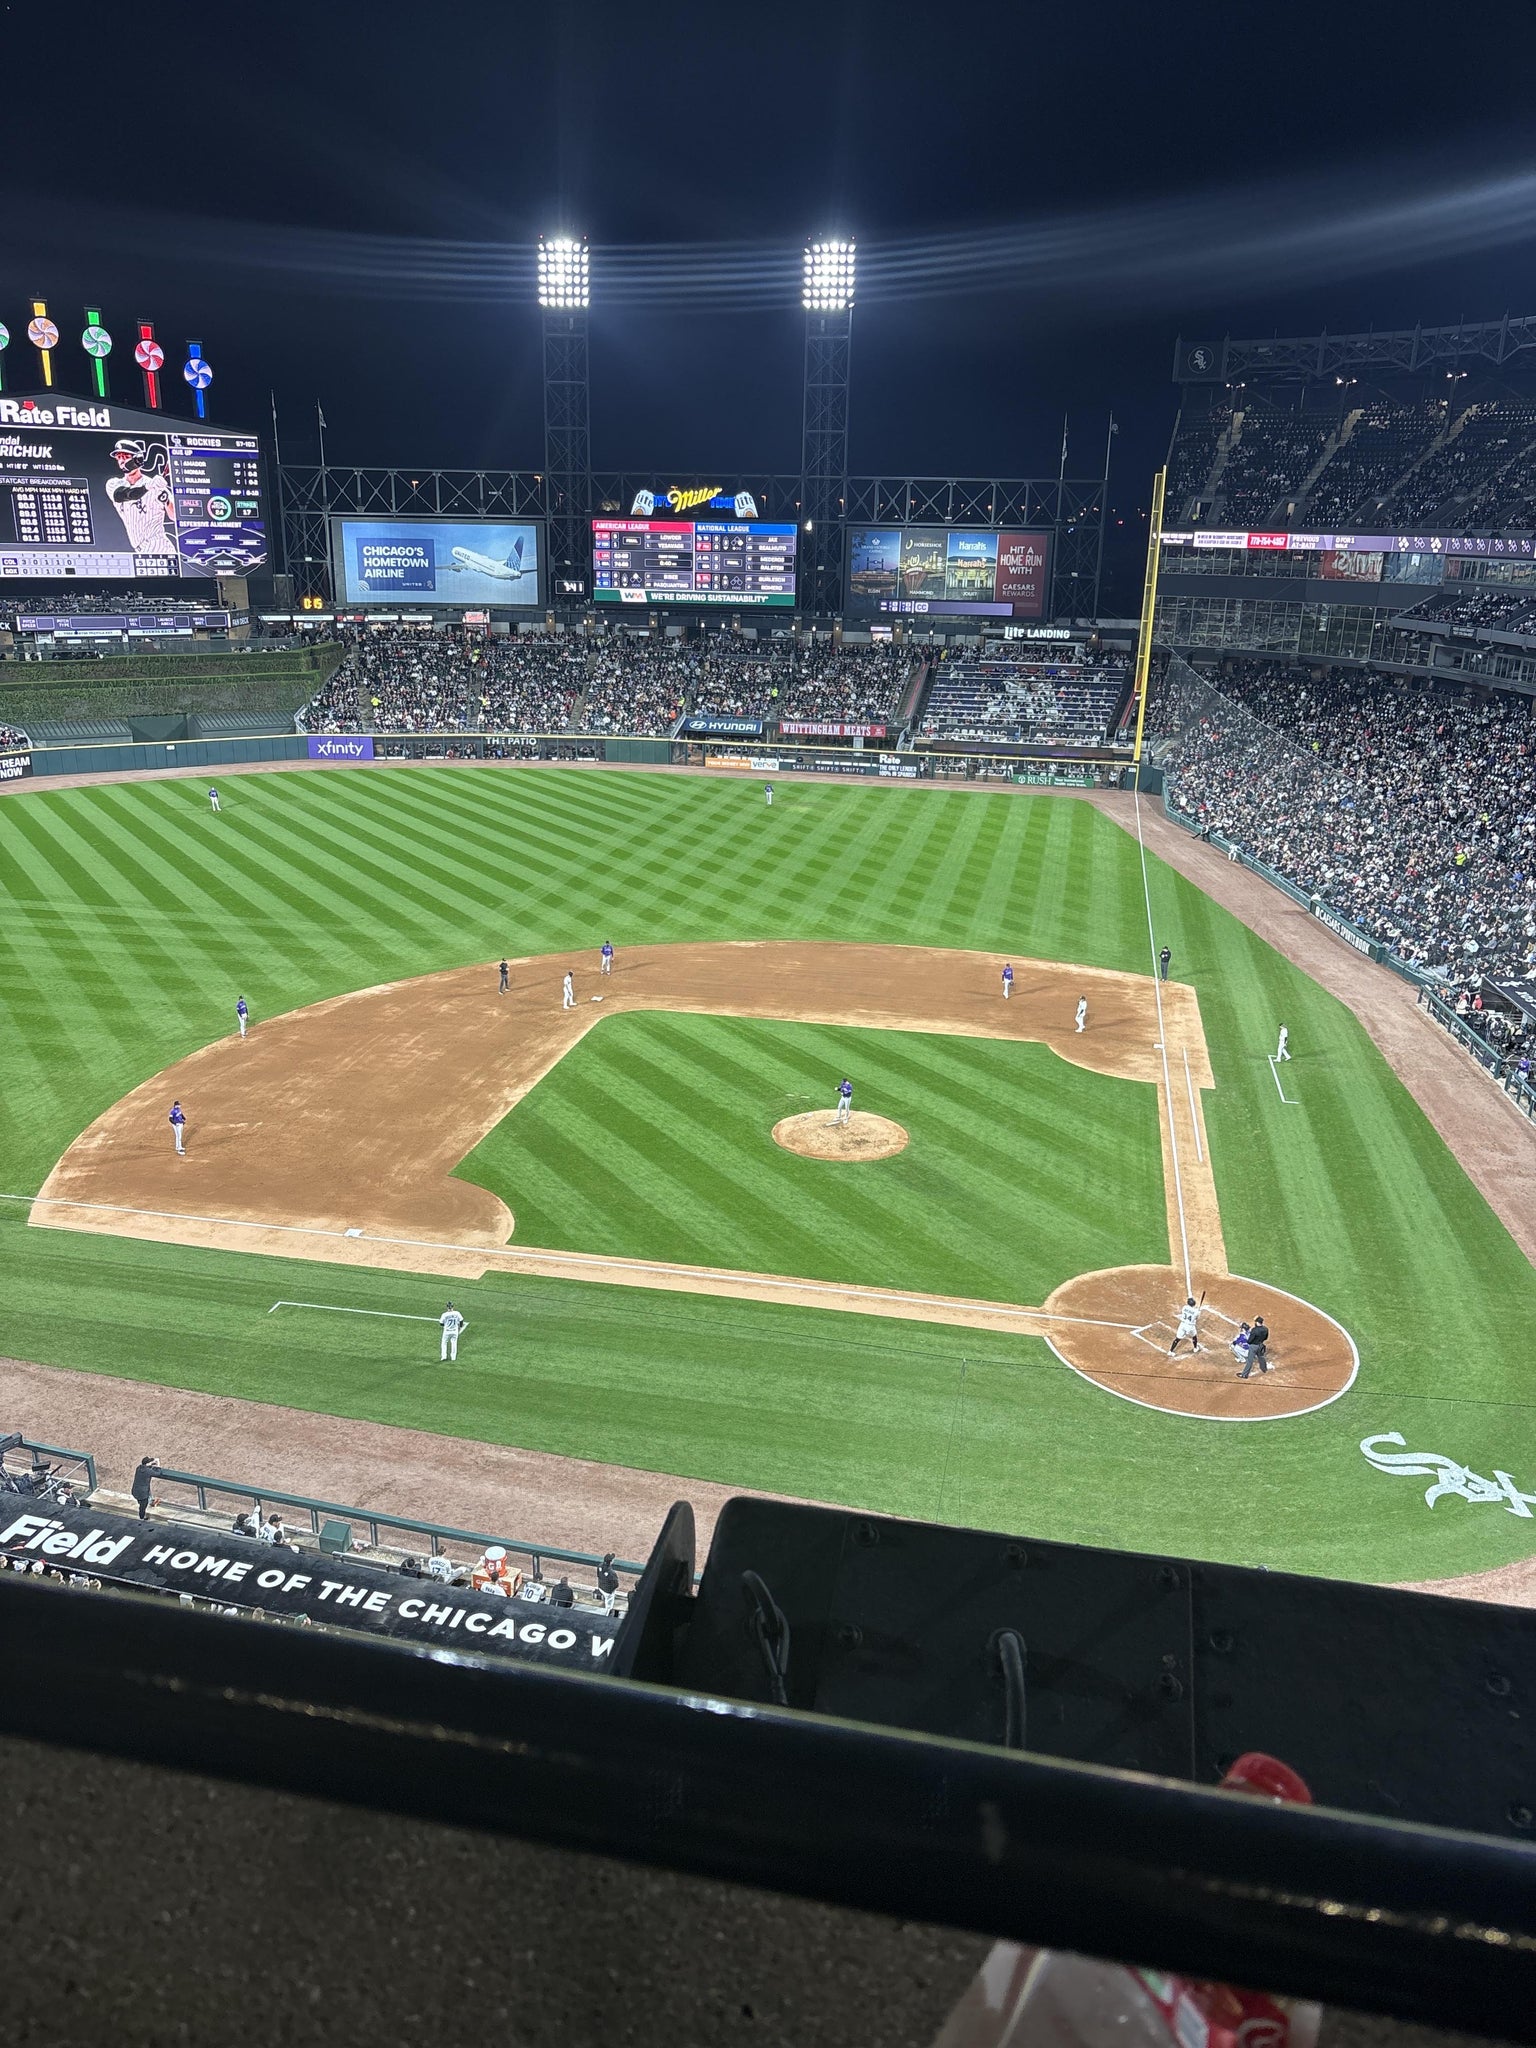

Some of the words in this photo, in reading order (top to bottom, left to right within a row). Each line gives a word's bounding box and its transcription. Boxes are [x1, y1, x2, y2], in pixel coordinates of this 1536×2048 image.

[0, 400, 54, 425] Rate
[56, 406, 111, 428] Field
[187, 438, 221, 447] ROCKIES
[636, 494, 653, 507] Lite
[667, 487, 723, 513] Miller
[737, 495, 753, 510] Lite
[362, 545, 424, 556] CHICAGO'S
[959, 541, 987, 550] Harrah's
[1010, 546, 1025, 554] HIT
[454, 550, 471, 561] UNITED
[1000, 555, 1024, 565] HOME
[1026, 555, 1042, 566] RUN
[364, 558, 429, 568] HOMETOWN
[365, 569, 405, 578] AIRLINE
[1008, 567, 1032, 575] WITH
[916, 603, 927, 611] CC
[0, 622, 11, 630] CK
[1004, 627, 1024, 639] Lite
[1027, 629, 1070, 639] LANDING
[709, 722, 756, 732] HYUNDAI
[783, 723, 840, 735] WHITTINGHAM
[844, 726, 871, 736] MEATS
[485, 737, 505, 745] THE
[507, 737, 537, 745] PATIO
[317, 741, 363, 757] xfinity
[879, 754, 900, 764] Rate
[1, 767, 23, 778] NOW
[1027, 776, 1052, 785] RUSH
[1320, 909, 1341, 934] CAESARS
[1183, 1313, 1192, 1321] 34
[0, 1514, 135, 1565] Field
[142, 1545, 254, 1583] HOME
[256, 1569, 313, 1593] OF
[321, 1580, 393, 1615] THE
[398, 1598, 577, 1650] CHICAGO
[525, 1589, 534, 1599] 10
